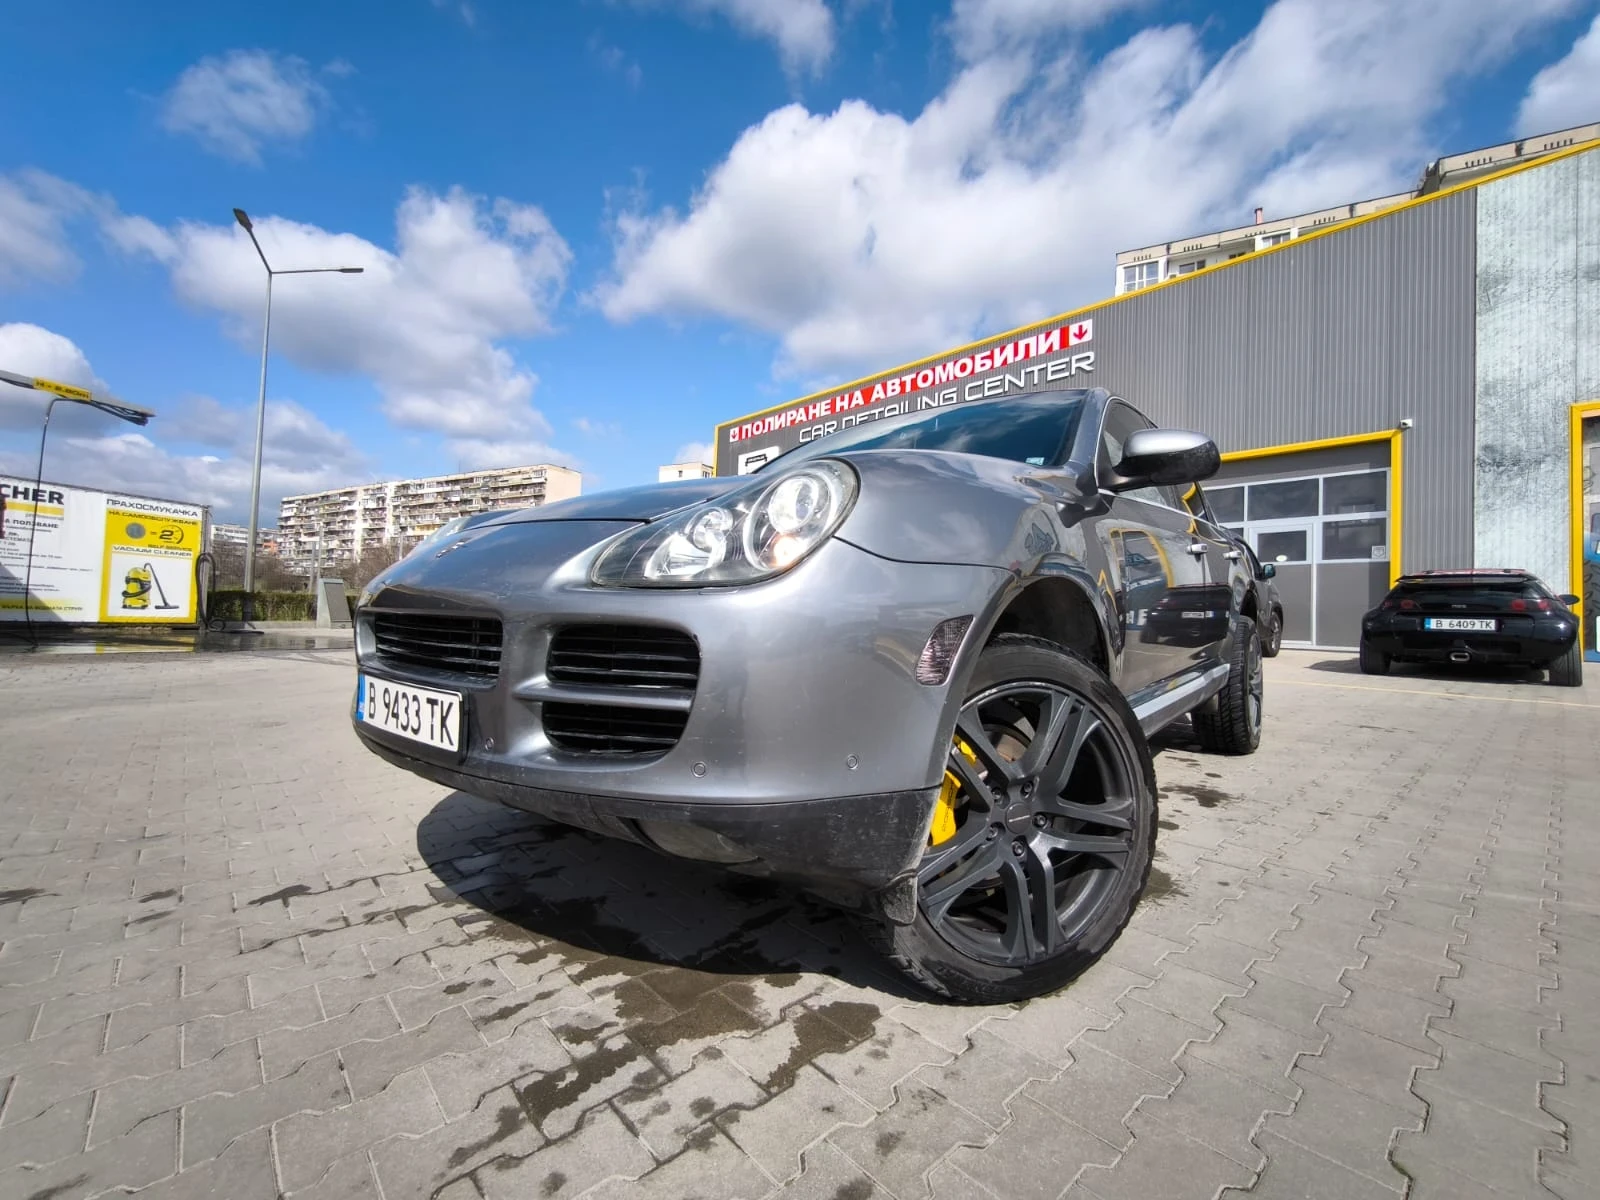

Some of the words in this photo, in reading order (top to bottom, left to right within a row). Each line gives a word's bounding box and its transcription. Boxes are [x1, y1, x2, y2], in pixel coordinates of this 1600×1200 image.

[741, 398, 832, 440] ПОЛИРАНЕ
[835, 391, 865, 413] НА
[869, 327, 1061, 402] АВТОМОБИЛИ
[799, 420, 838, 443] CAR
[964, 351, 1095, 401] CENTER
[106, 498, 198, 517] ПРАХОСМУКАЧКА
[159, 529, 174, 540] 2
[112, 545, 152, 553] VACUUM
[153, 548, 192, 557] CLEANER
[1435, 619, 1443, 628] B
[1448, 620, 1476, 629] 6409
[1479, 620, 1493, 629] TK
[368, 681, 376, 719] B
[383, 687, 421, 736] 9433
[426, 697, 454, 746] TK
